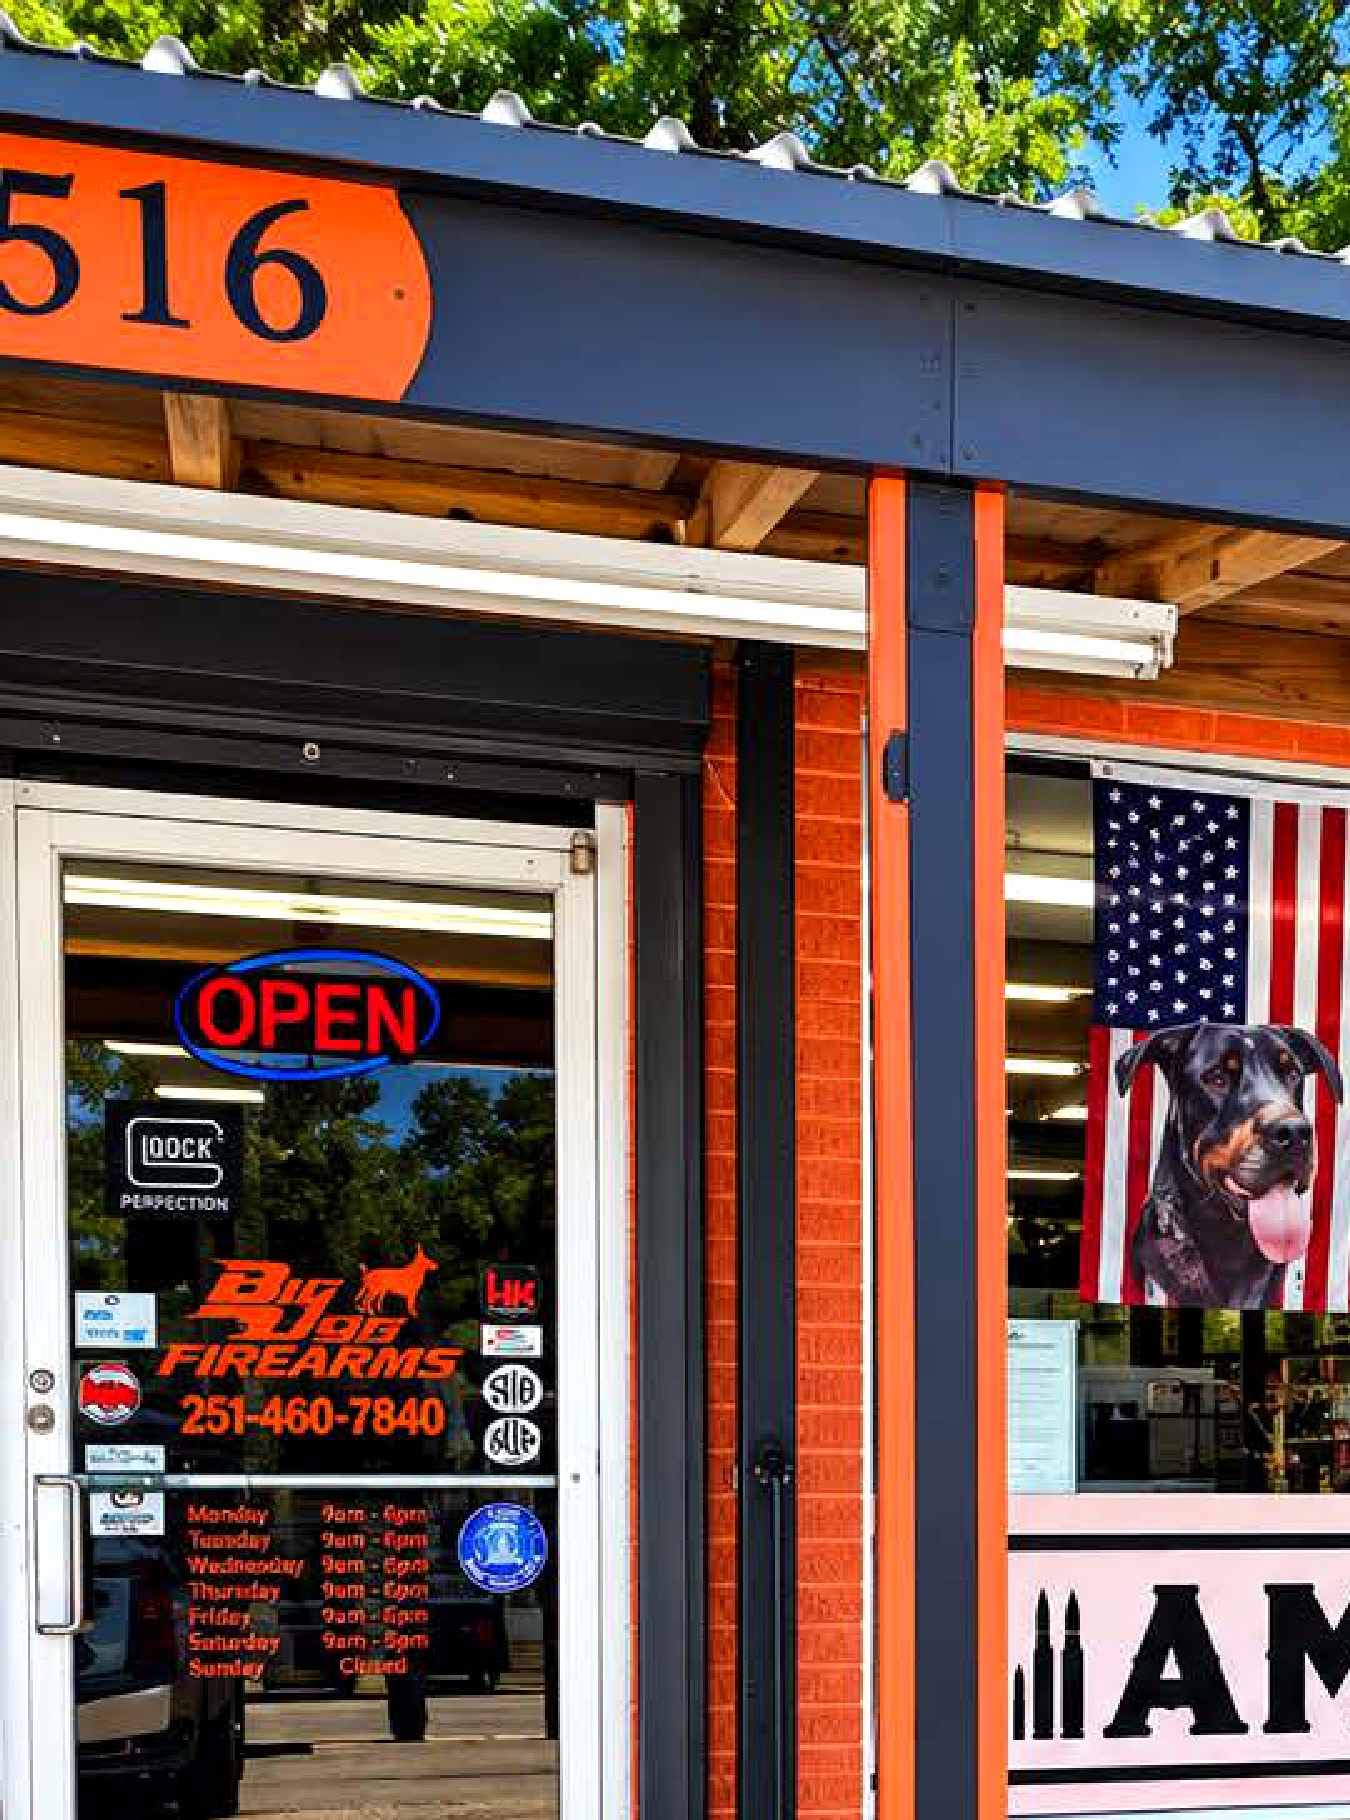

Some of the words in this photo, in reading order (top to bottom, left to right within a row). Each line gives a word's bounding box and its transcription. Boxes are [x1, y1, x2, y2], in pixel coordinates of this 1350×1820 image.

[0, 168, 327, 343] 516
[198, 976, 417, 1055] OPEN
[119, 1194, 229, 1211] PERFECTION
[157, 1343, 464, 1379] FIREARMS
[179, 1395, 446, 1436] 251-460-7840
[187, 1504, 268, 1525] Monday
[188, 1529, 271, 1553] Tuesday
[186, 1554, 305, 1578] Wednesday
[187, 1580, 280, 1604] Thursday
[188, 1606, 251, 1631] Friday
[188, 1632, 281, 1655] Saturday
[188, 1657, 264, 1680] Sunday
